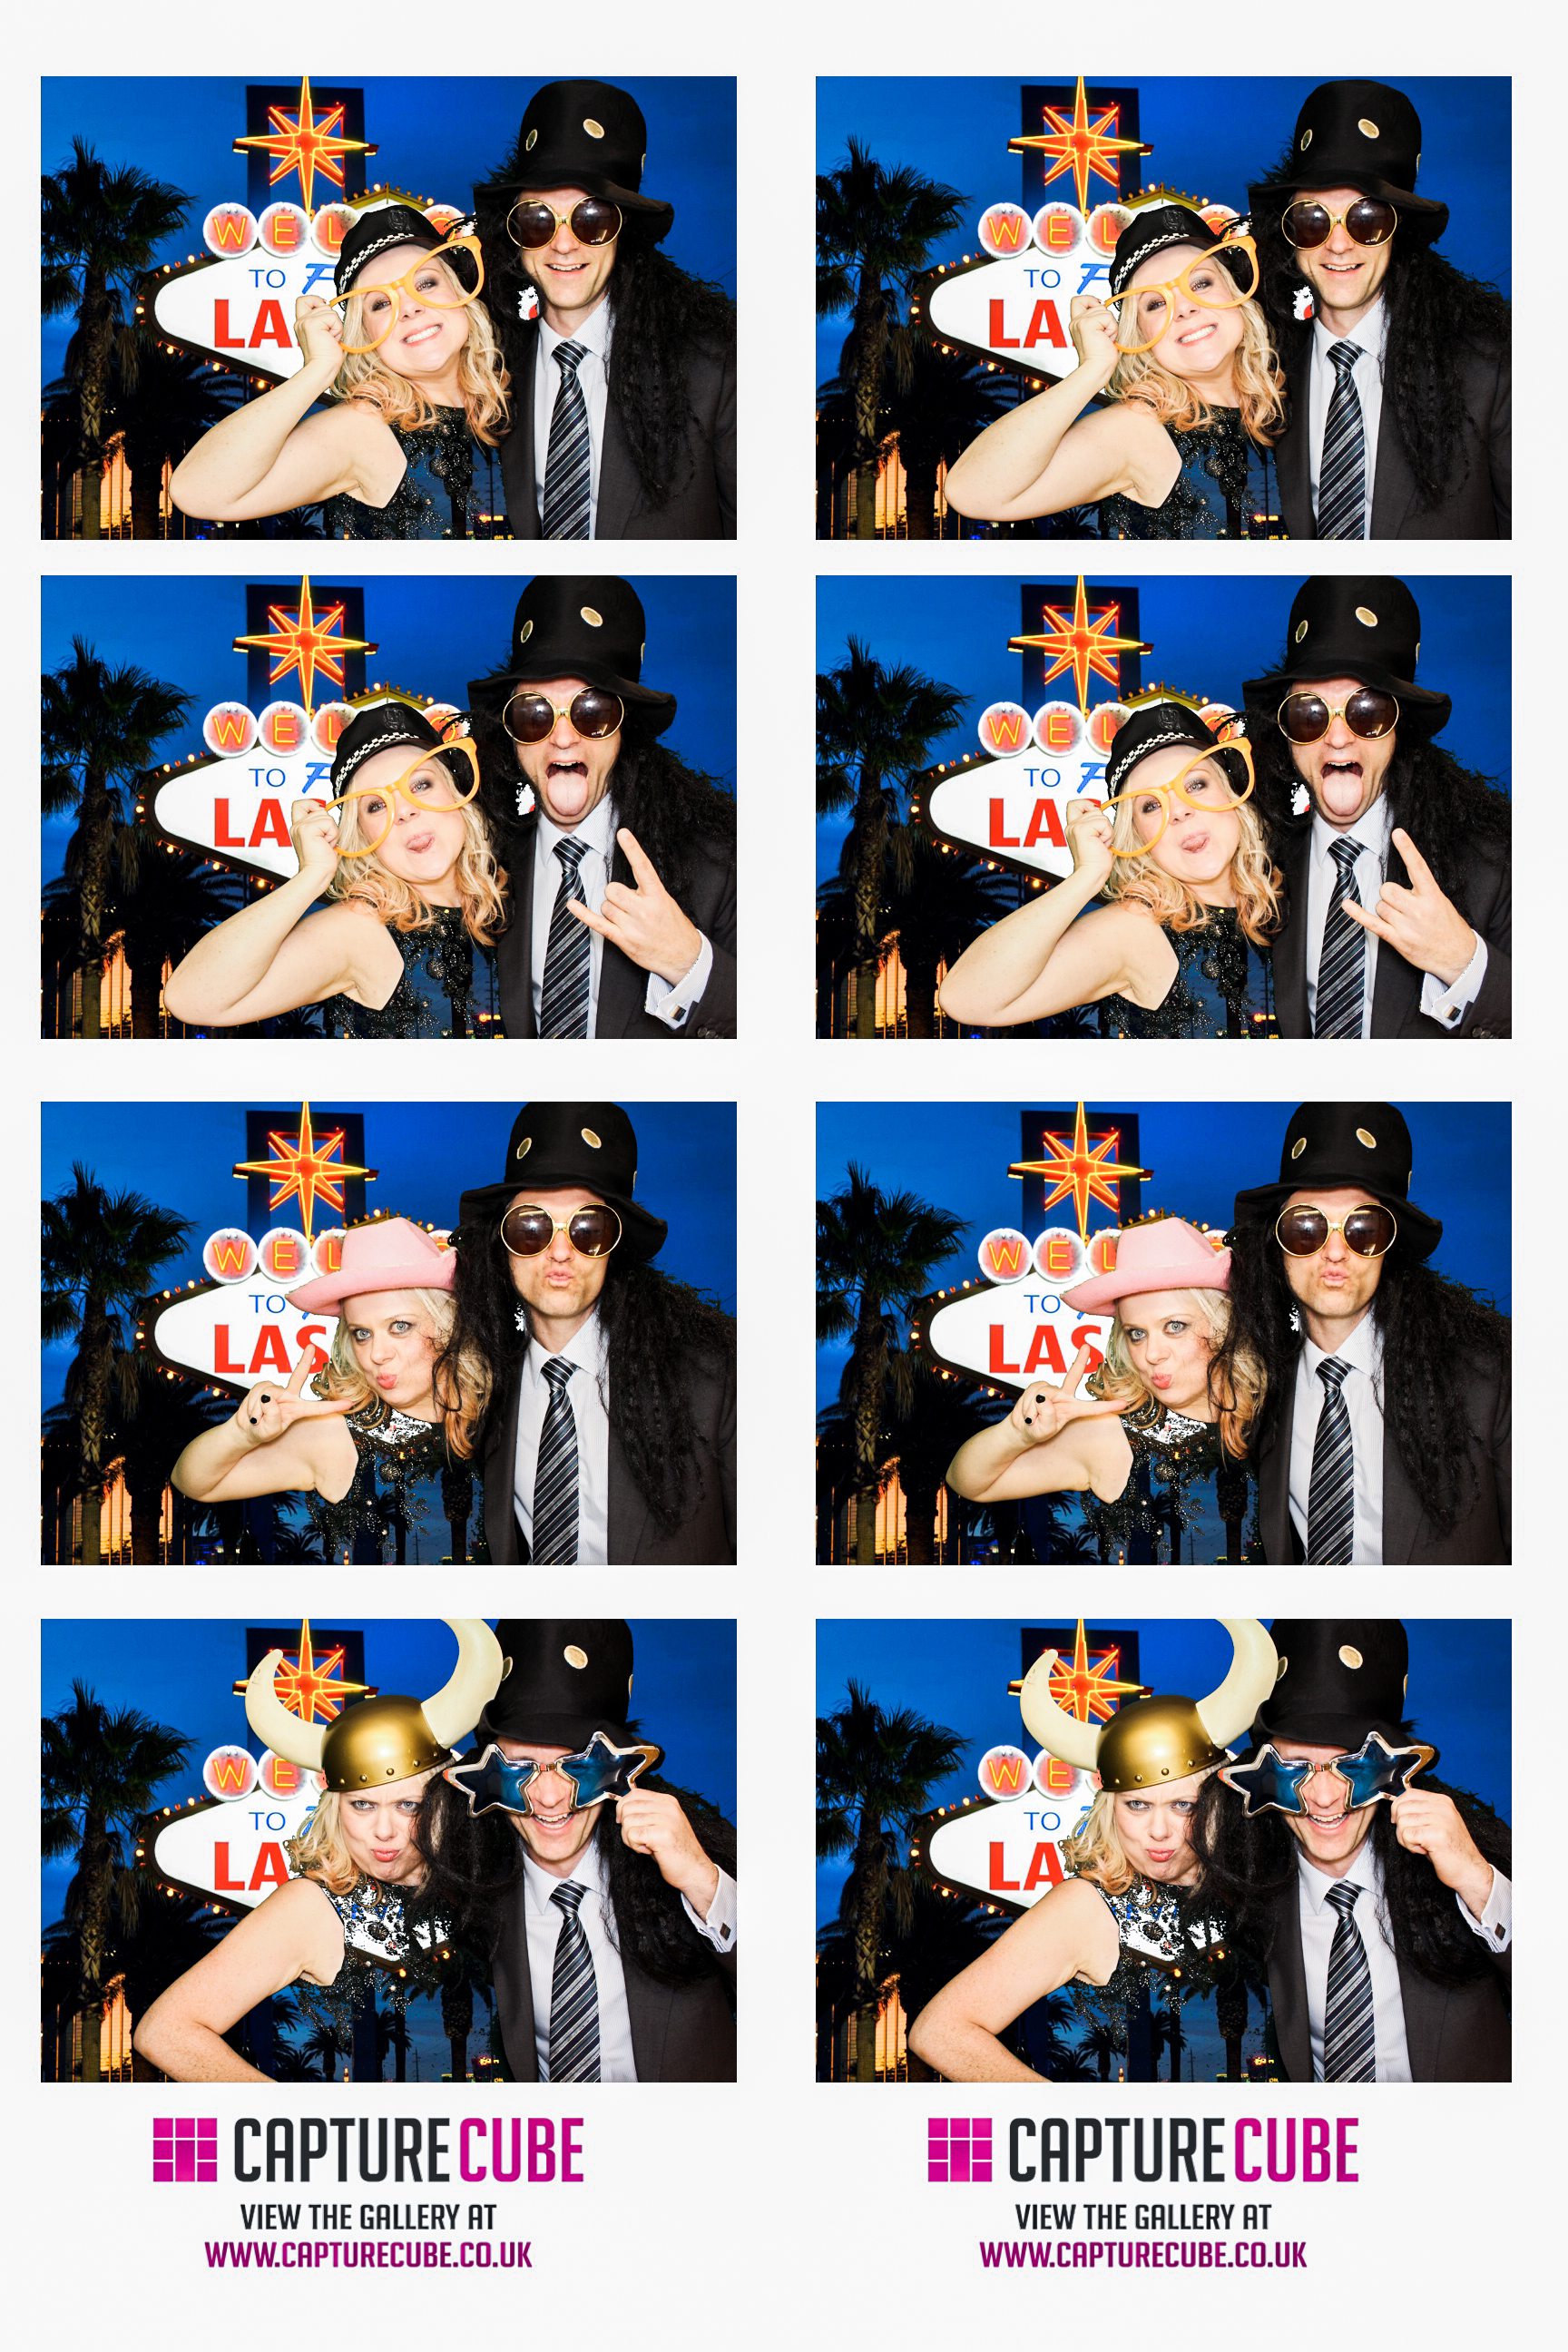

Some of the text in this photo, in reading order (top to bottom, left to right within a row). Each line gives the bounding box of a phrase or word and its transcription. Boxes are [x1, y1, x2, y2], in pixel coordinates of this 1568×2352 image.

[248, 269, 287, 289] TO
[1023, 269, 1062, 289] TO
[214, 299, 300, 348] LA
[989, 299, 1075, 348] LA
[248, 768, 287, 788] TO
[1023, 768, 1062, 788] TO
[214, 798, 326, 848] LA
[989, 798, 1101, 848] LA
[248, 1294, 287, 1314] TO
[1023, 1294, 1062, 1314] TO
[214, 1324, 330, 1374] LAS
[989, 1324, 1105, 1374] LAS
[248, 1811, 287, 1831] TO
[1023, 1811, 1062, 1831] TO
[214, 1841, 289, 1891] LA
[989, 1841, 1064, 1891] LA
